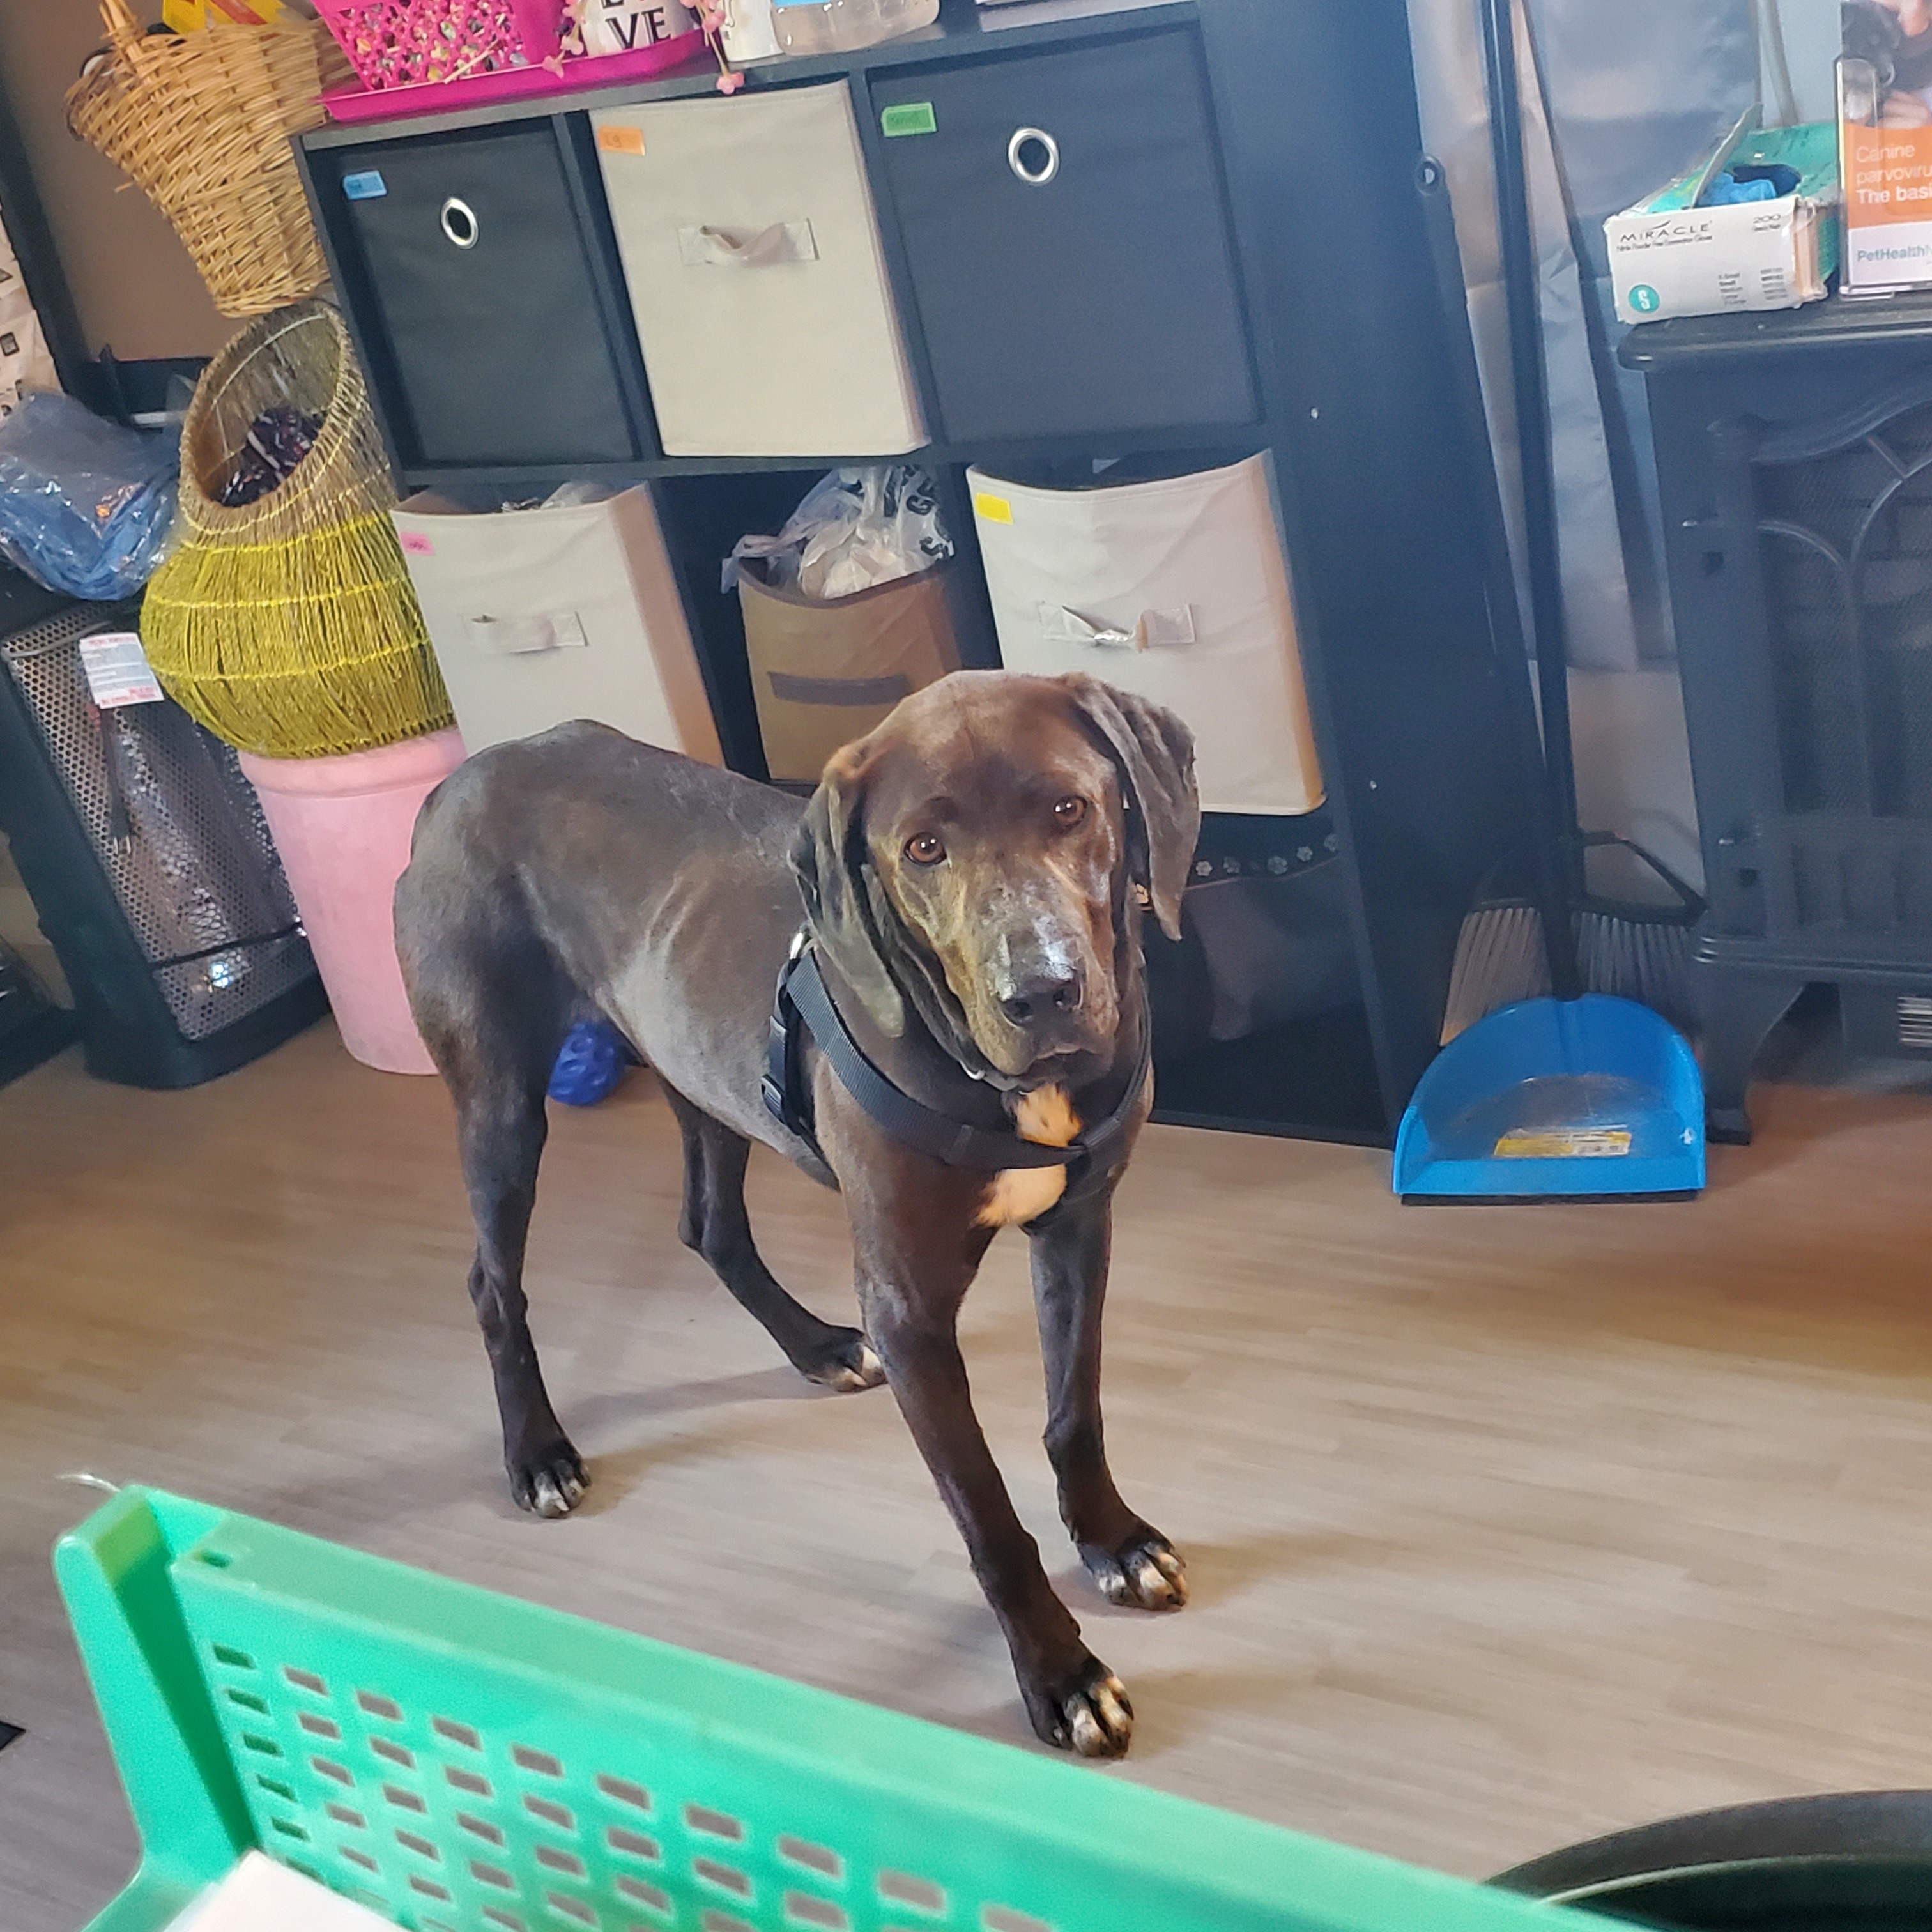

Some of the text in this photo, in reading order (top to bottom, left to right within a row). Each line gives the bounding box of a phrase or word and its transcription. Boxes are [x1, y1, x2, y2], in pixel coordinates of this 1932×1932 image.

[1856, 144, 1915, 163] Canine
[1856, 189, 1890, 204] The
[1752, 214, 1781, 224] 200
[1620, 222, 1710, 242] MIRACLE
[1637, 290, 1650, 310] S
